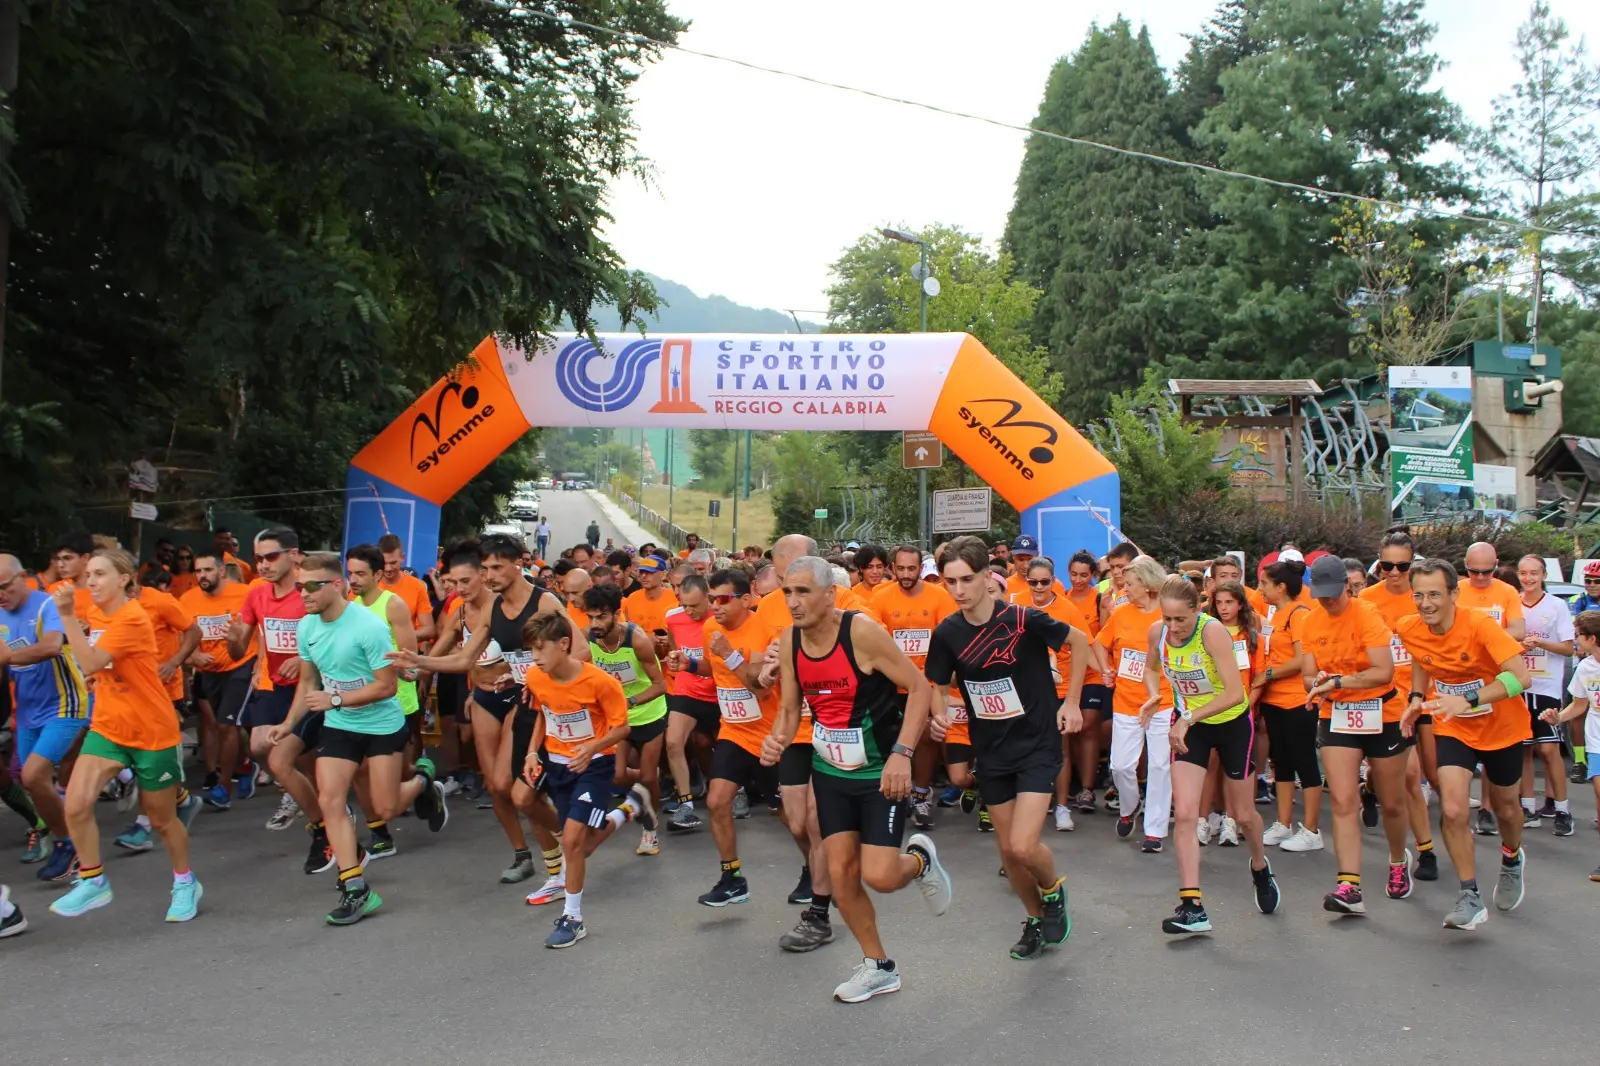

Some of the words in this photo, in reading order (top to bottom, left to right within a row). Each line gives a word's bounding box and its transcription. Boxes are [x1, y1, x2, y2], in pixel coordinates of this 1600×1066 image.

[718, 340, 886, 351] CENTRO
[717, 354, 885, 370] SPORTIVO
[716, 373, 885, 390] ITALIANO
[715, 400, 783, 414] REGGIO
[793, 400, 887, 414] CALABRIA
[416, 404, 495, 473] syemme
[958, 406, 1034, 481] syemme
[275, 631, 297, 647] 155
[903, 640, 921, 652] 127
[1128, 661, 1144, 677] 492
[1174, 680, 1200, 694] 179
[725, 701, 747, 717] 148
[980, 695, 1006, 713] 180
[1347, 711, 1364, 728] 58
[556, 723, 574, 737] 71
[826, 744, 844, 763] 11
